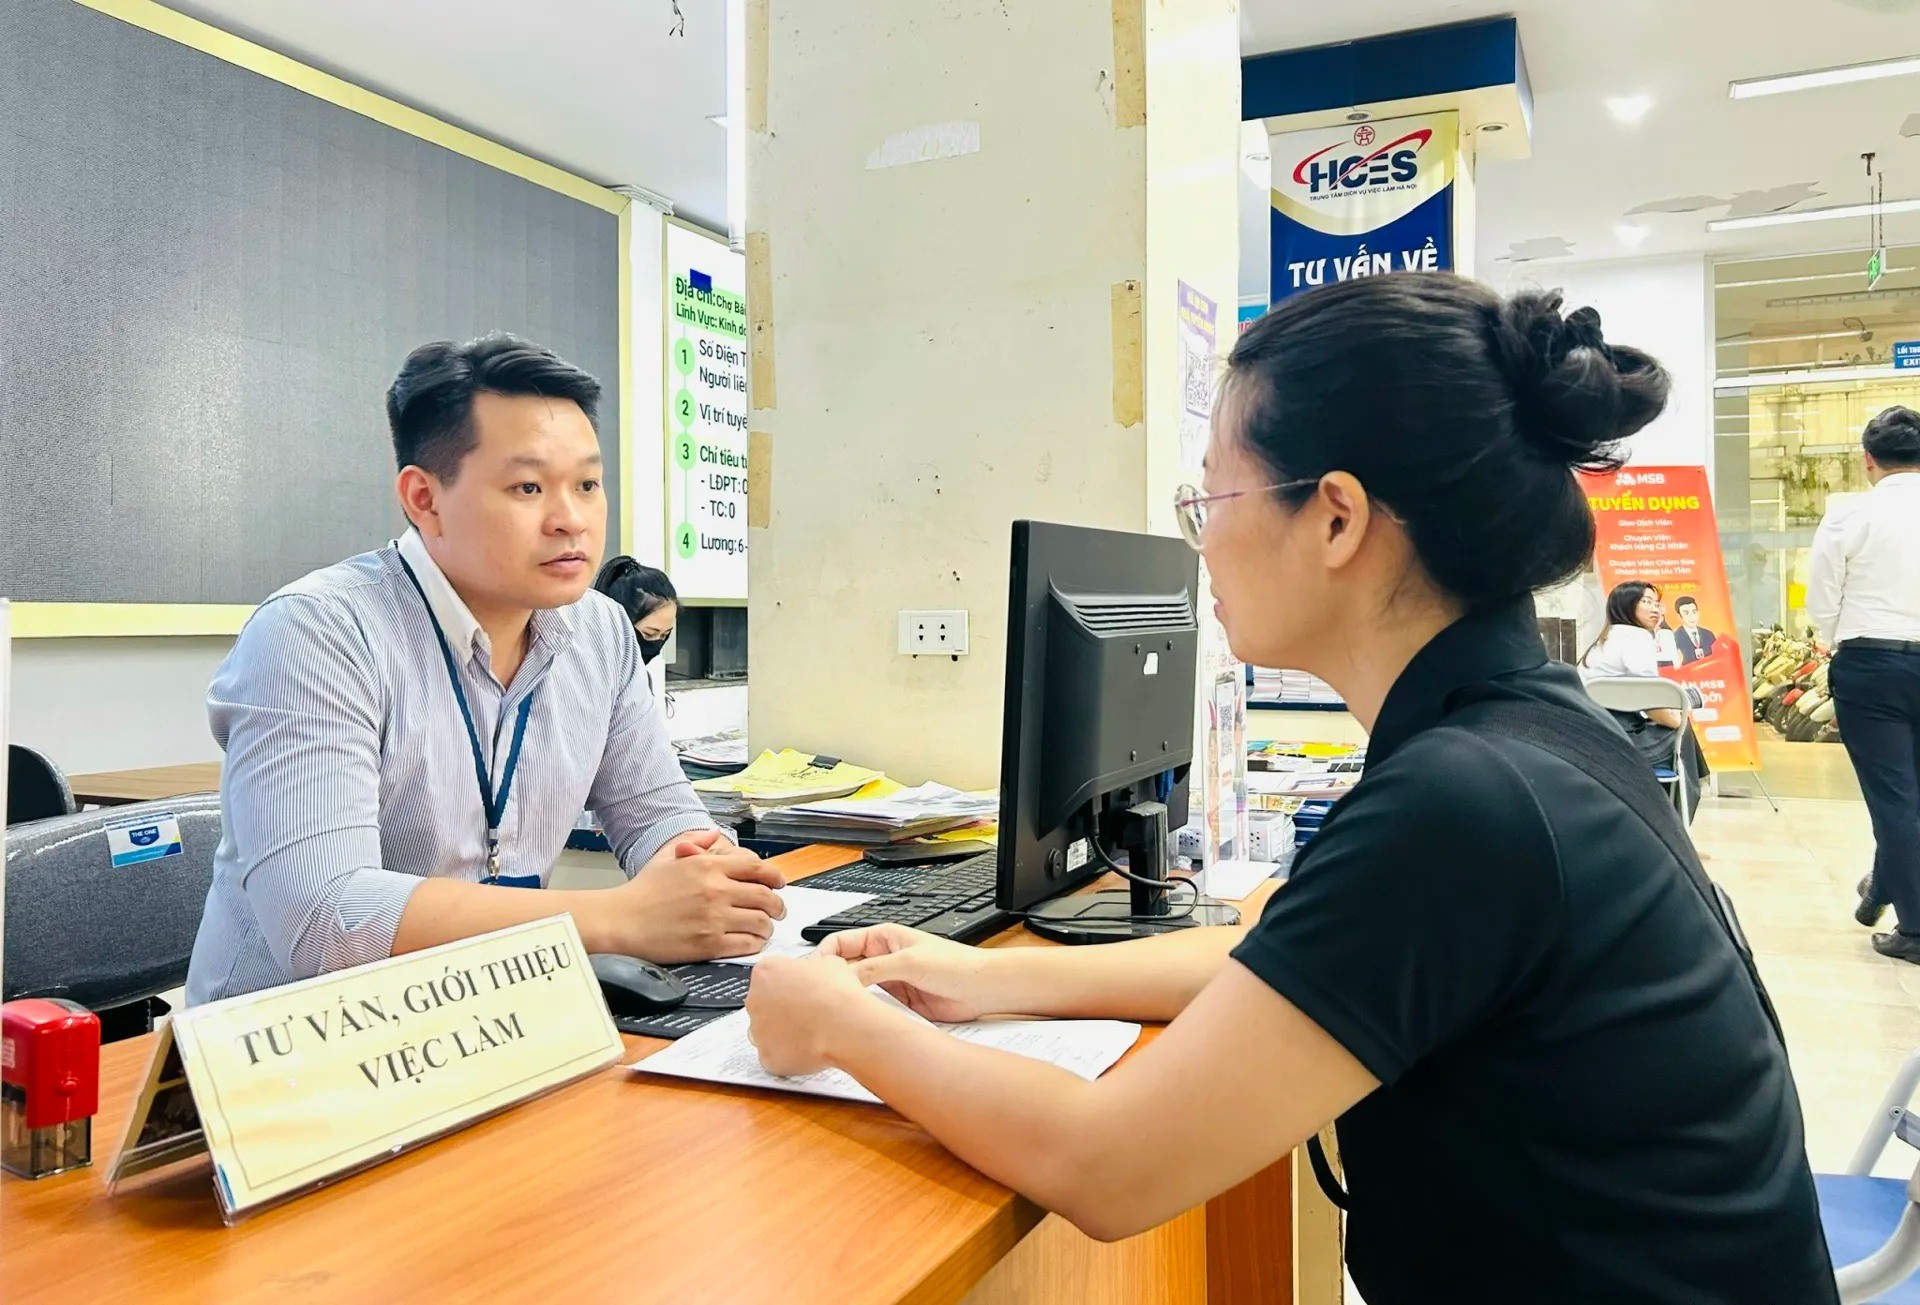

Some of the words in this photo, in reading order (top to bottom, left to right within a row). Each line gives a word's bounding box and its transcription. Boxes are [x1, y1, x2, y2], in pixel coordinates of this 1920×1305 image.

[1406, 182, 1417, 190] NỘI
[1288, 258, 1326, 288] TƯ
[1333, 244, 1392, 282] VẤN
[1401, 236, 1438, 273] VỀ
[676, 277, 694, 300] Địa
[676, 302, 695, 321] Lĩnh
[719, 316, 736, 333] Kinh
[682, 349, 687, 365] 1
[700, 339, 713, 358] Số
[716, 344, 738, 367] Điện
[700, 366, 731, 389] Người
[682, 399, 689, 416] 2
[700, 403, 710, 426] Vị
[713, 408, 725, 423] trí
[683, 443, 689, 459] 3
[700, 446, 718, 463] Chỉ
[720, 449, 739, 467] tiêu
[1637, 473, 1665, 484] MSB
[1588, 491, 1644, 511] TUYỂN
[1648, 496, 1700, 514] DỤNG
[1636, 519, 1654, 527] Dịch
[1655, 518, 1673, 526] Viên
[683, 533, 689, 549] 4
[1634, 543, 1654, 551] Hàng
[1700, 680, 1725, 689] MSB
[238, 1016, 294, 1066] TƯ
[304, 995, 400, 1043] VẤN,
[403, 966, 480, 1014] GIỚI
[480, 942, 574, 991] THIỆU
[357, 1037, 449, 1090] VIỆC
[450, 1011, 526, 1059] LÀM
